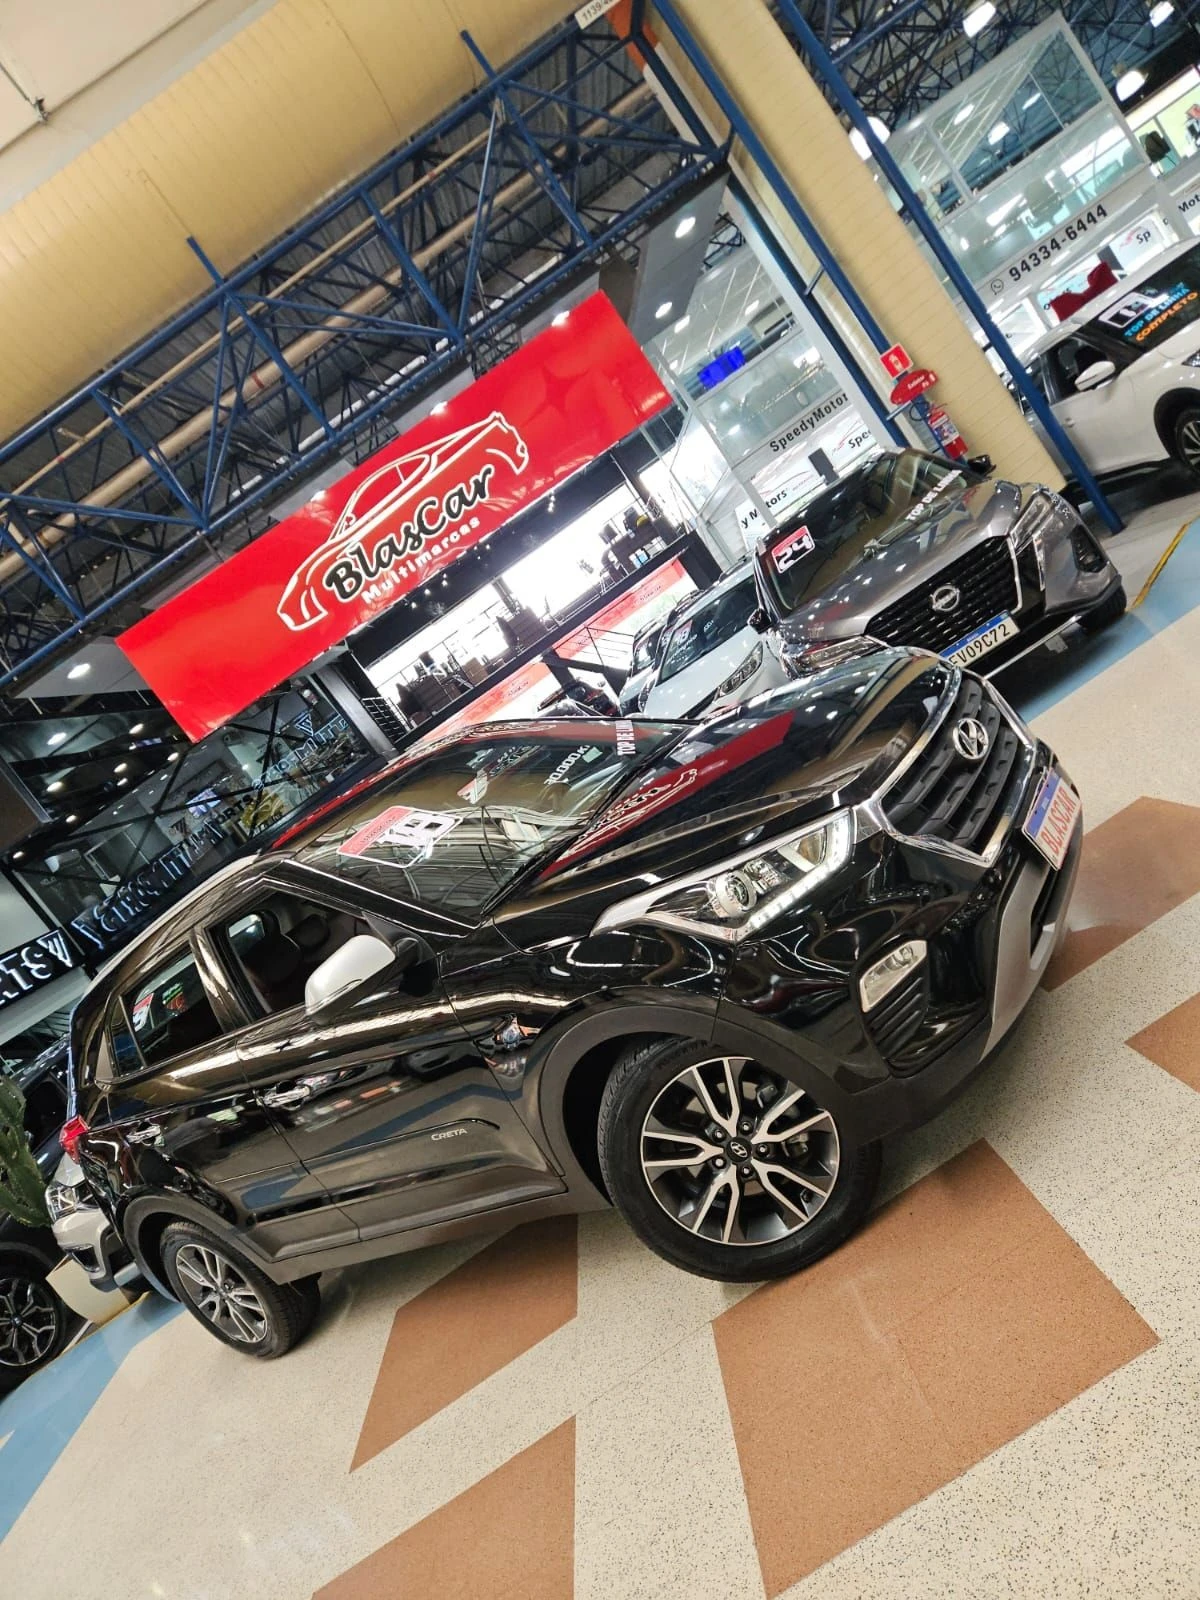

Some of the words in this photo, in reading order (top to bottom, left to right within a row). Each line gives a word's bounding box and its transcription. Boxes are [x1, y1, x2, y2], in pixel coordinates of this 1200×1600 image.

[1009, 204, 1108, 282] 94334-6444
[1124, 320, 1144, 337] TOP
[1145, 308, 1160, 321] DE
[1135, 291, 1198, 341] COMPLETO
[848, 429, 872, 449] Spe
[905, 503, 924, 520] TOP
[921, 490, 938, 504] DE
[323, 465, 494, 602] BlasCar
[778, 533, 813, 569] 24
[361, 517, 481, 604] Multimarcas
[617, 742, 636, 756] TOP
[1040, 786, 1077, 855] BLASCAR
[431, 1128, 468, 1141] CRETA
